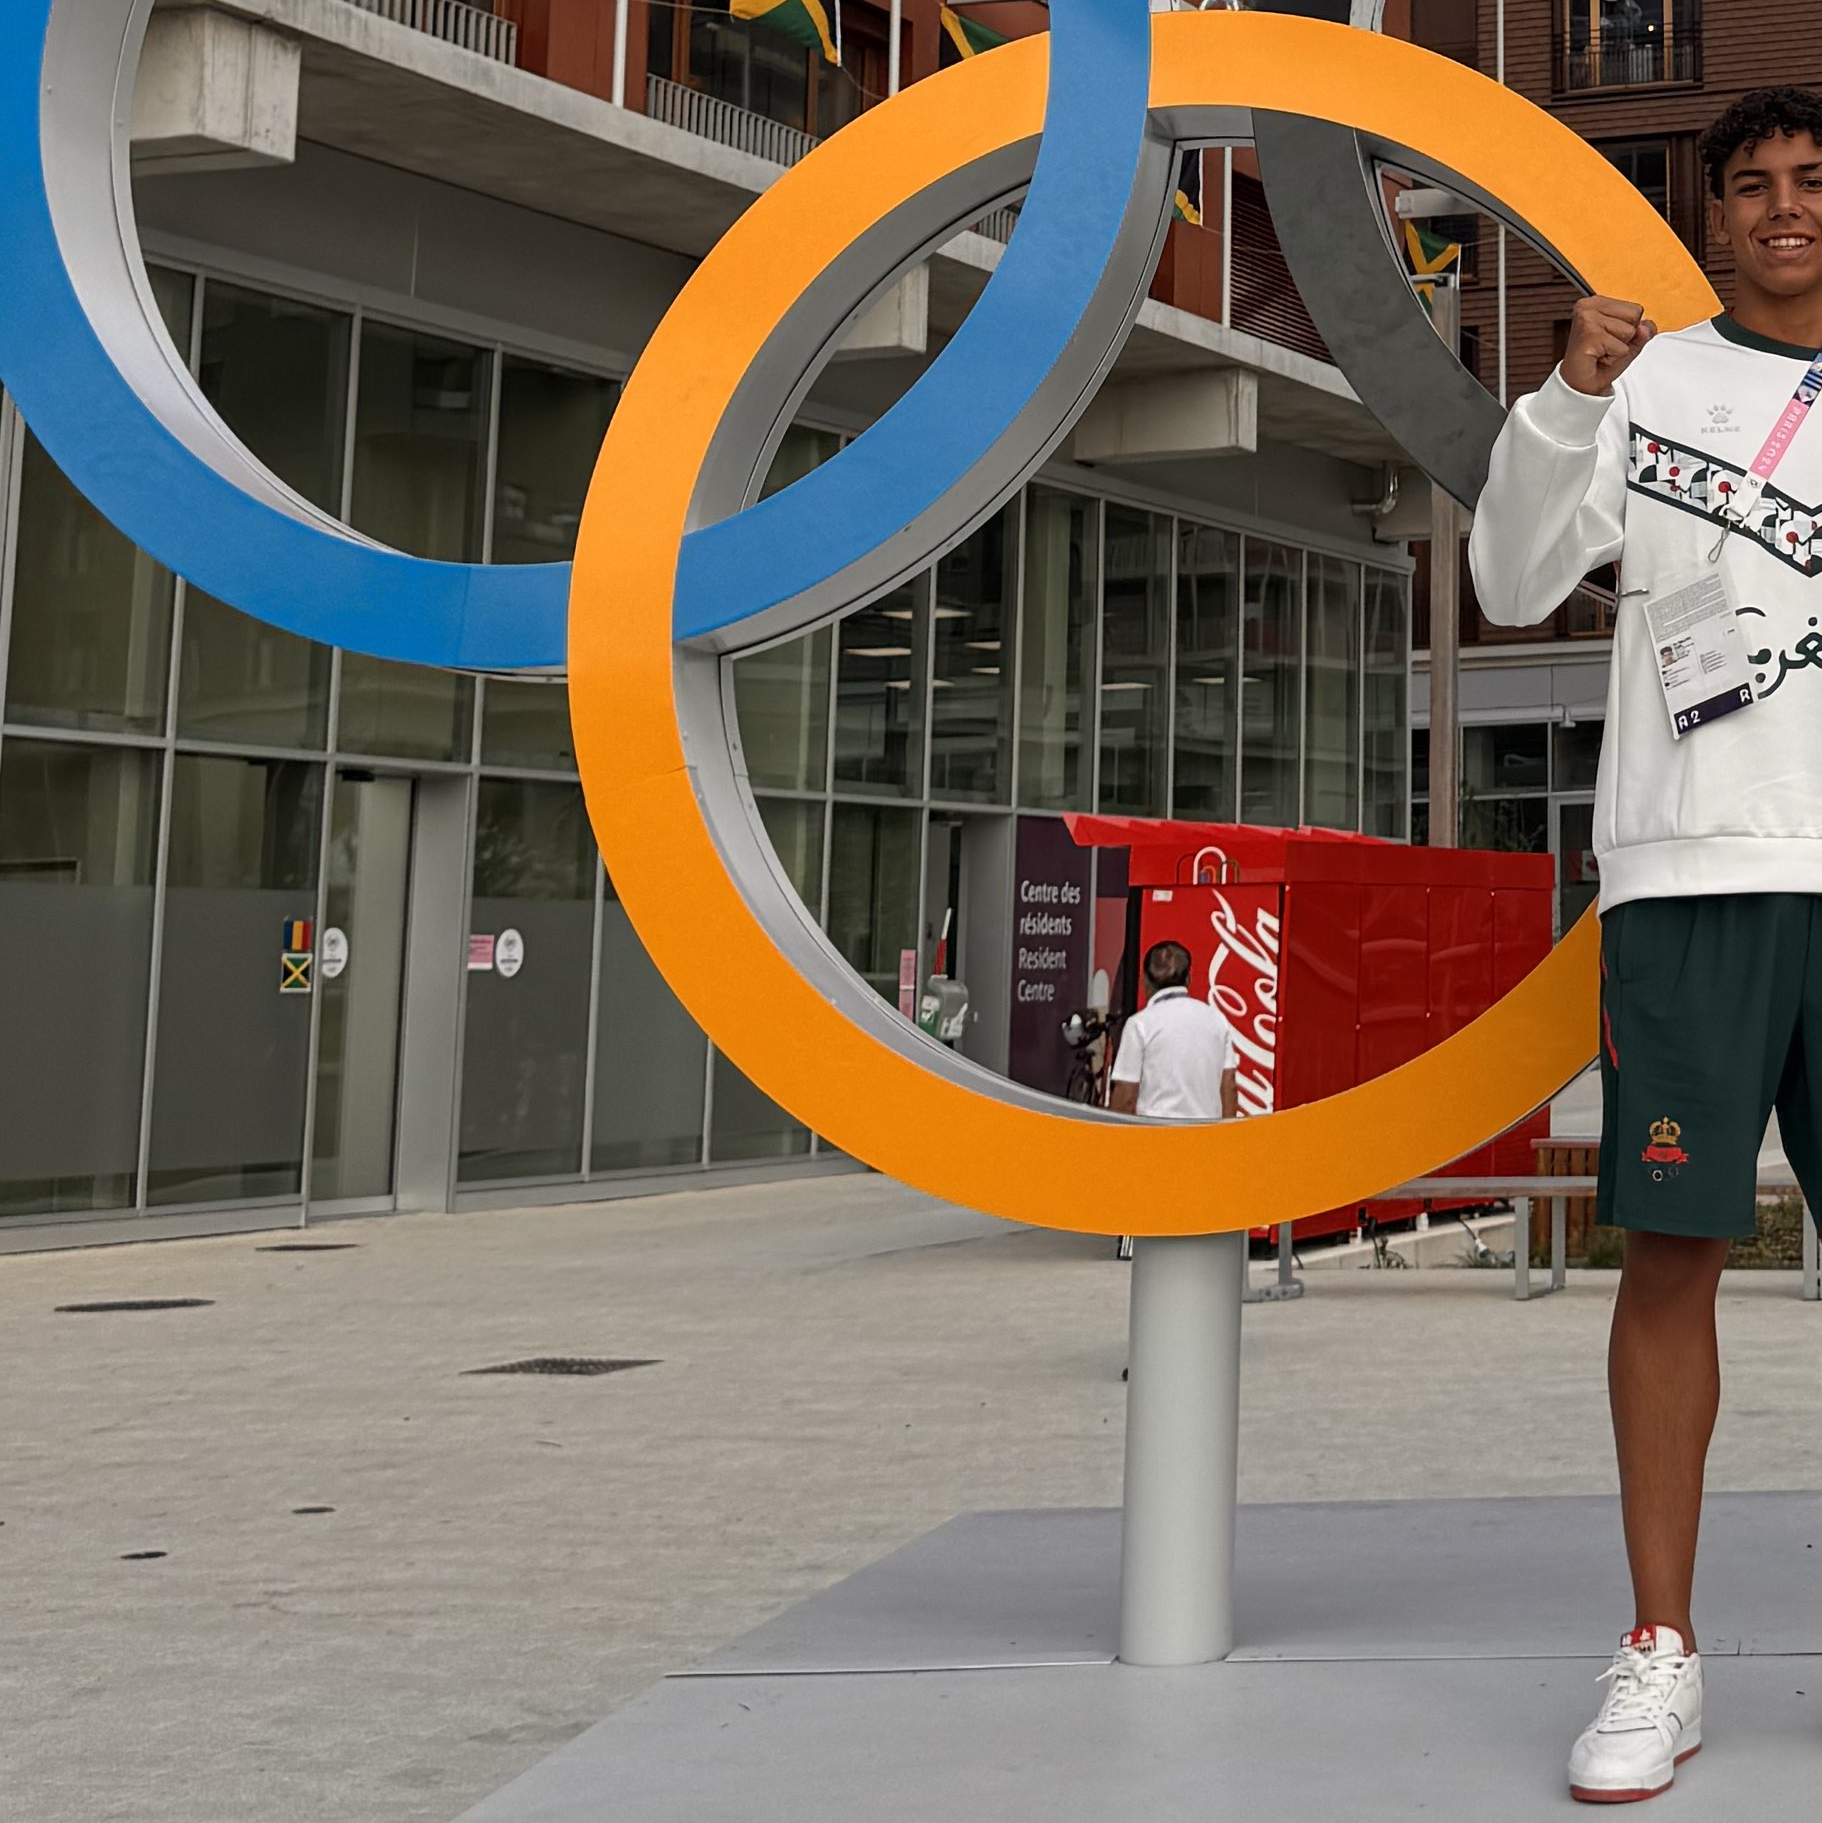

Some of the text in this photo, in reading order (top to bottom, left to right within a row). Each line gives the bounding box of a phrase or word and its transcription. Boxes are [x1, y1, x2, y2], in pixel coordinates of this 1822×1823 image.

[1020, 880, 1081, 904] Centre des
[1019, 912, 1072, 935] résidents
[1018, 946, 1067, 969] Resident
[1017, 979, 1056, 1001] Centre
